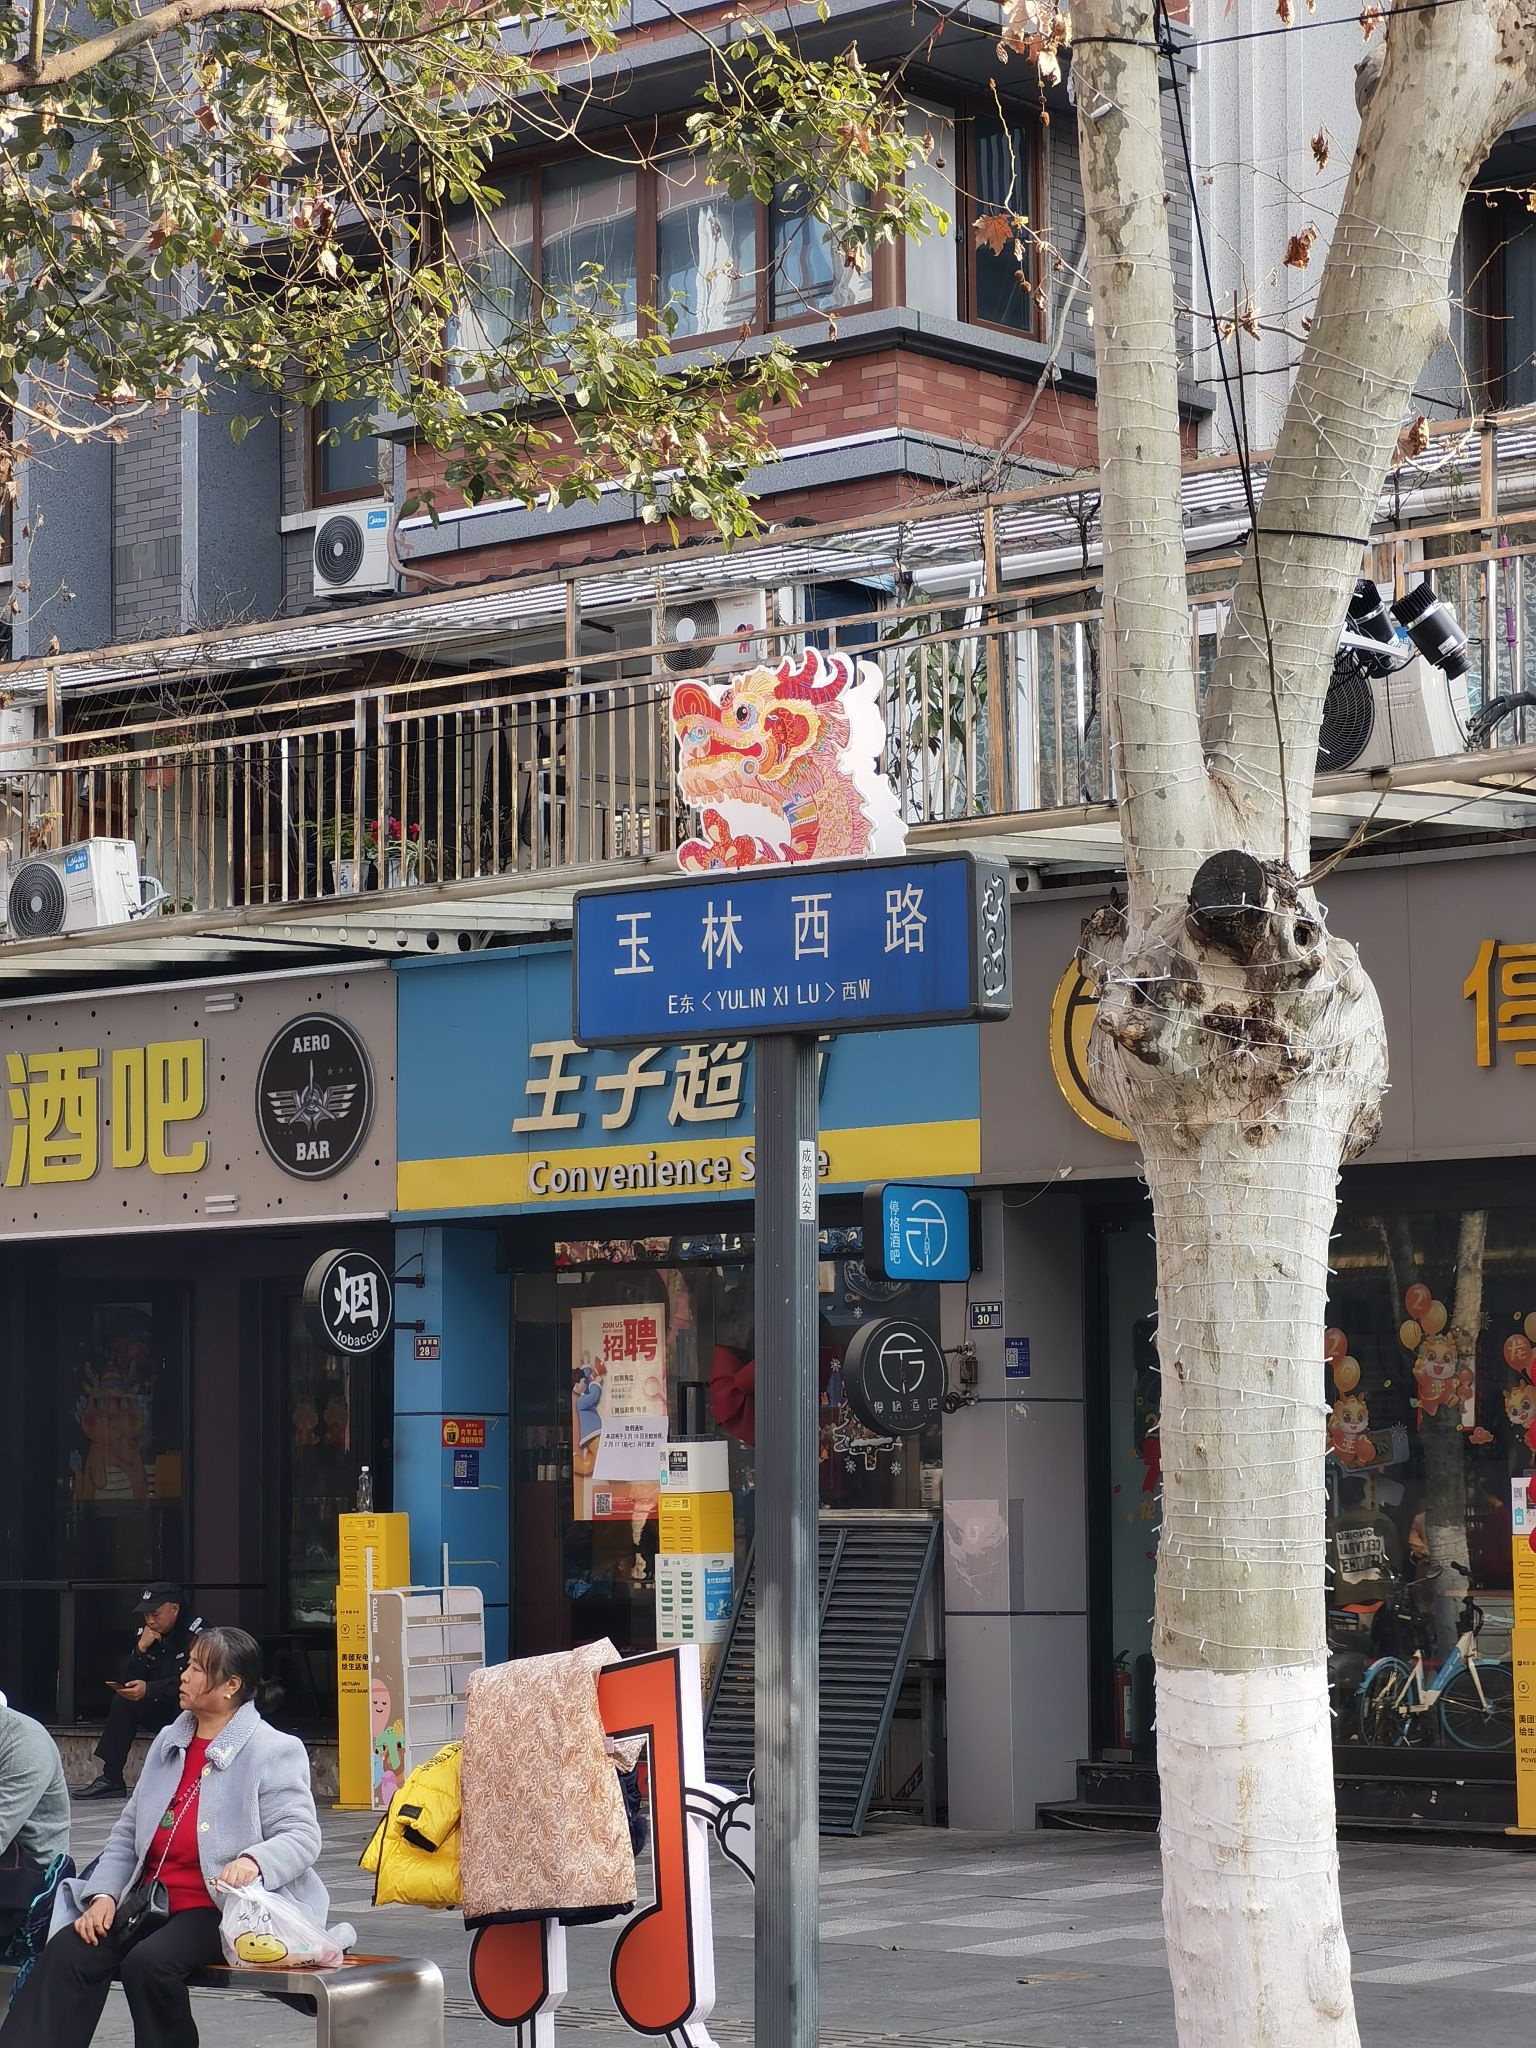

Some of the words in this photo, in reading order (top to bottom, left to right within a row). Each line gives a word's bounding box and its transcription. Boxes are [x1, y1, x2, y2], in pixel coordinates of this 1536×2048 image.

[614, 882, 928, 976] 玉林西路
[716, 987, 767, 1011] YULIN
[772, 985, 789, 1006] XI
[797, 982, 820, 1005] LU
[291, 1033, 331, 1054] AERO
[511, 1033, 831, 1133] 王子超
[5, 1038, 210, 1188] 酒吧
[295, 1140, 331, 1161] BAR
[529, 1151, 731, 1195] Convenience
[801, 1147, 813, 1215] 成都公安
[889, 1199, 901, 1265] 停格酒吧
[333, 1265, 380, 1329] 烟
[336, 1328, 380, 1347] tobacco
[601, 1321, 615, 1329] JOIN
[602, 1316, 658, 1362] 招聘
[976, 1314, 990, 1325] 30
[419, 1346, 430, 1356] 28
